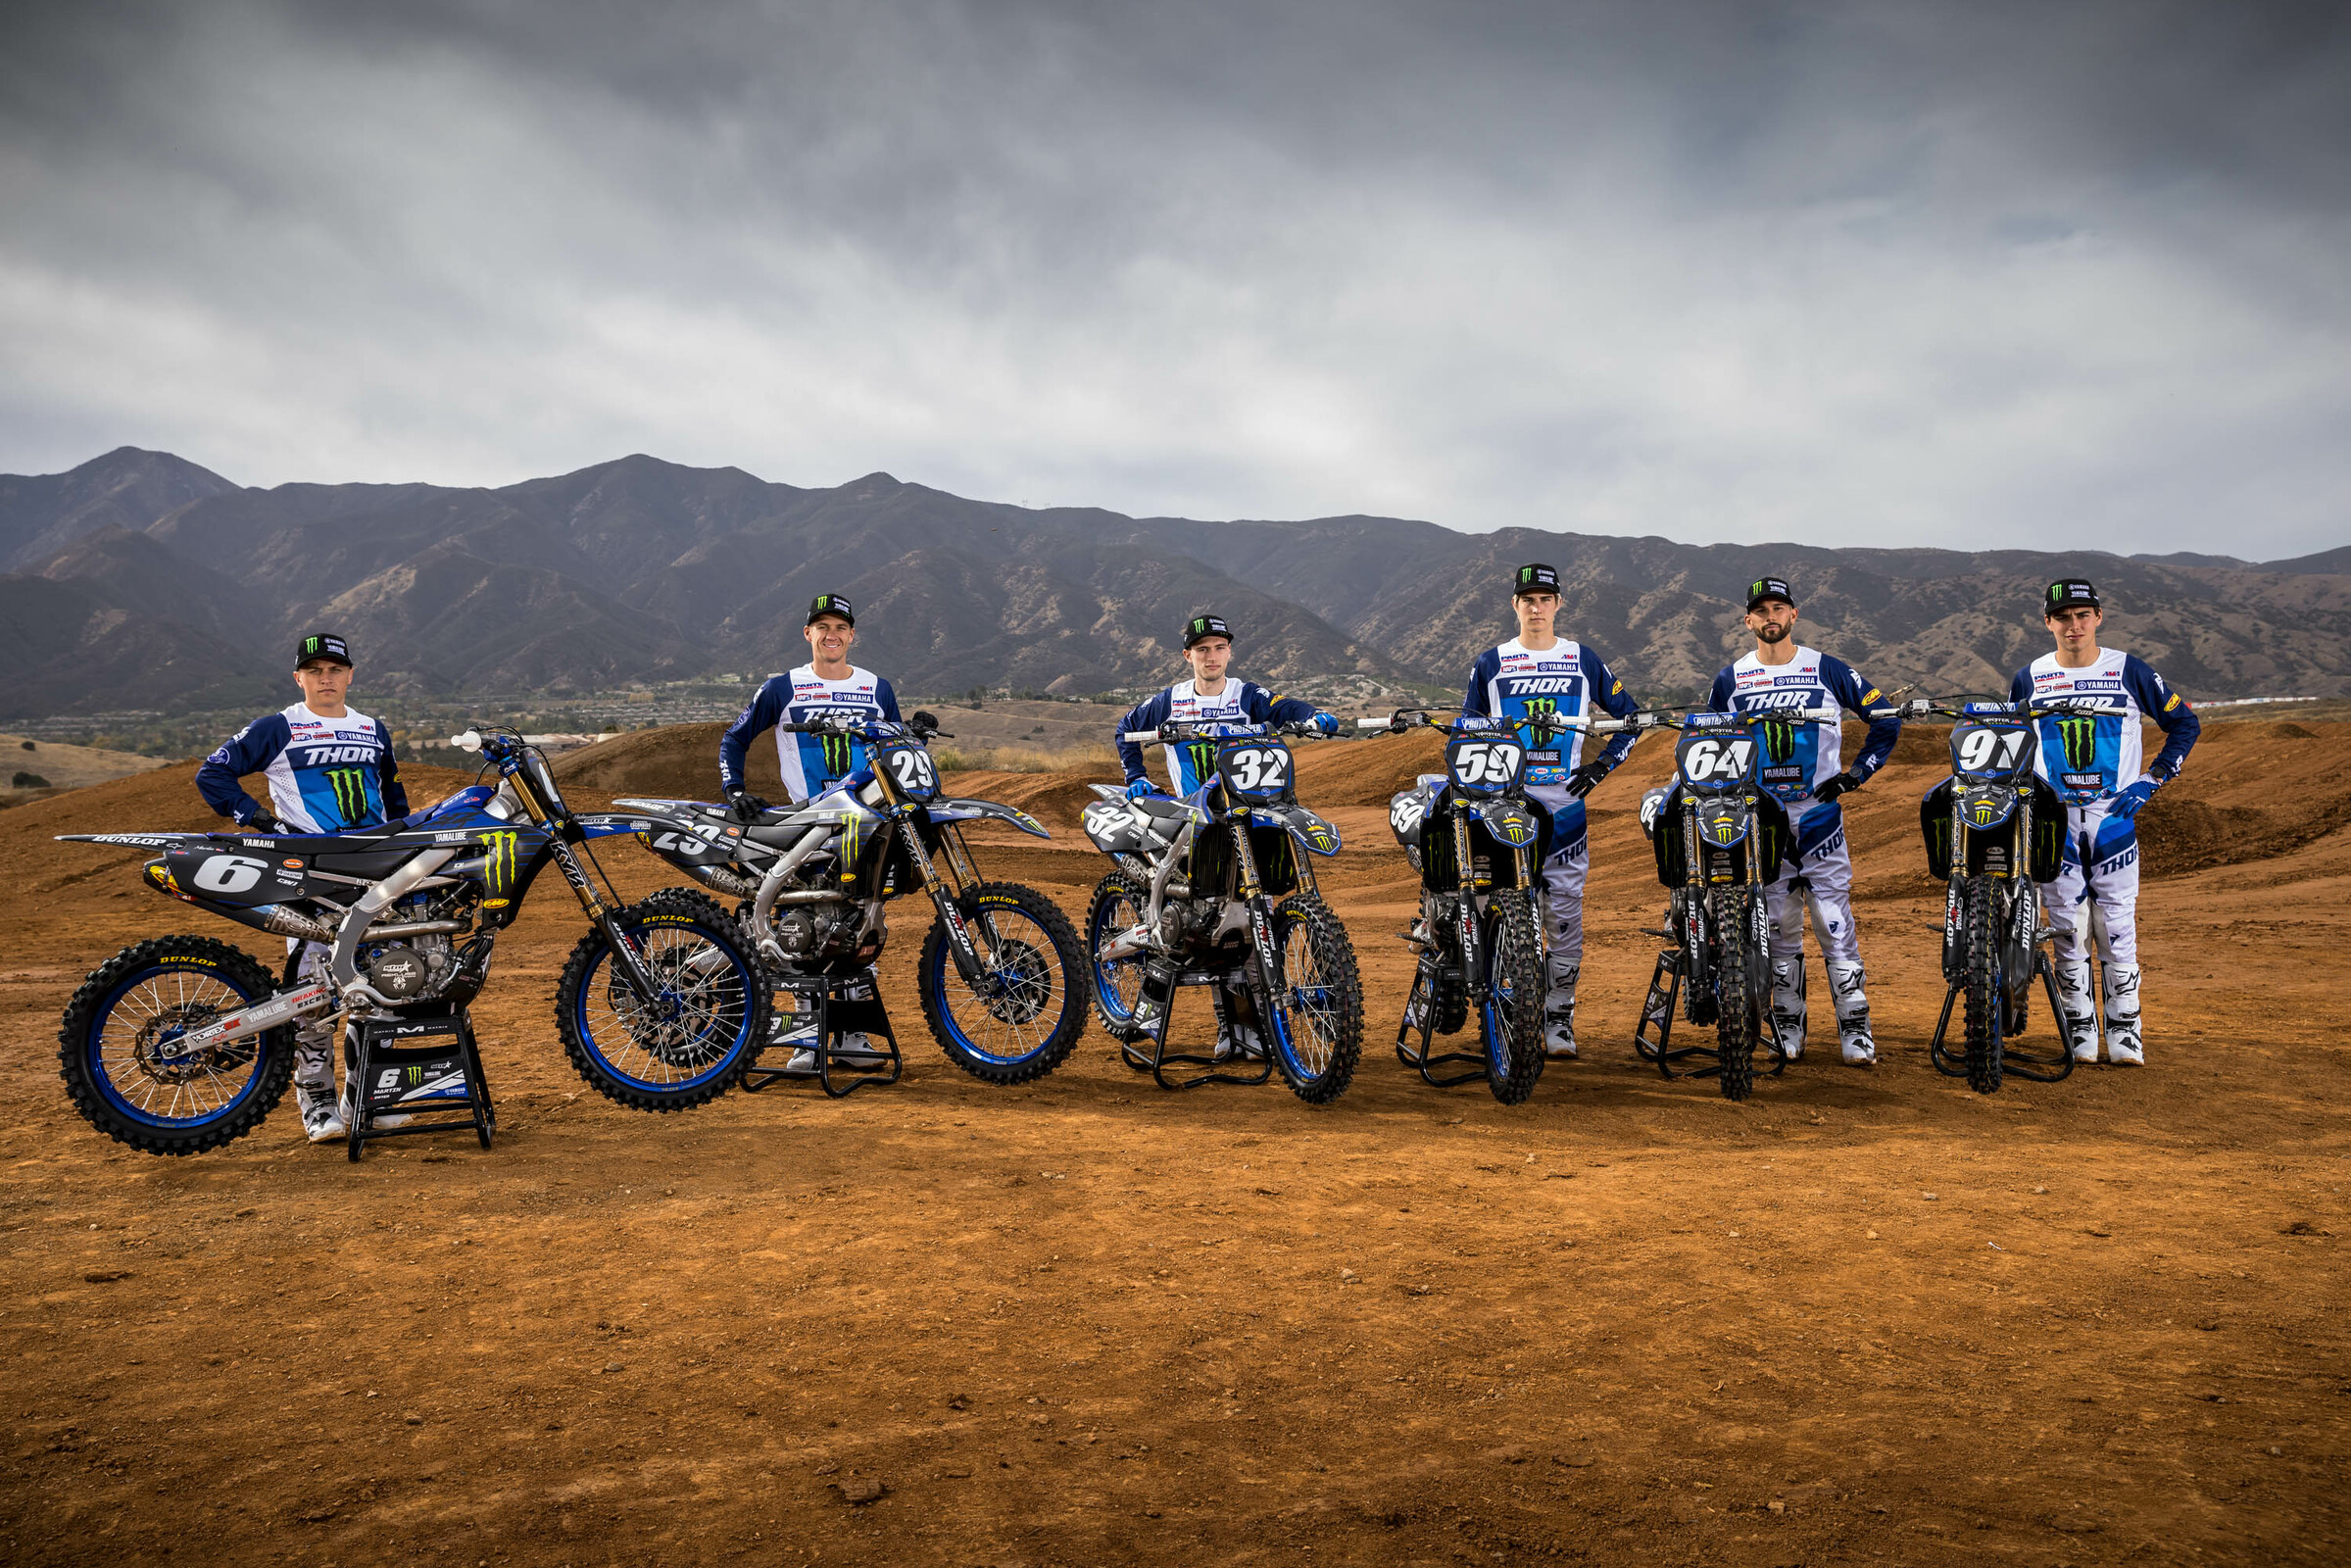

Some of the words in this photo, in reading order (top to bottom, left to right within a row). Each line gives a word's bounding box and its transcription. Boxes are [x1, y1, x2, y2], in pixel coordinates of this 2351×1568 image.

[2034, 671, 2065, 680] PARTS
[1508, 678, 1573, 695] THOR
[2086, 681, 2119, 690] YAMAHA
[1744, 691, 1812, 710] THOR
[1212, 708, 1238, 716] YAMAHA
[347, 733, 376, 743] YAMAHA
[304, 747, 376, 765] THOR
[1526, 752, 1559, 761] YAMALUBE
[1960, 729, 2027, 770] 91
[892, 750, 934, 789] 29
[1231, 749, 1289, 790] 32
[1455, 744, 1521, 783] 59
[1685, 740, 1752, 781] 64
[1764, 766, 1800, 778] YAMALUBE
[2063, 773, 2100, 785] YAMALUBE
[627, 801, 664, 810] DUNLOP
[706, 808, 726, 817] YAMAHA
[1391, 798, 1425, 833] 59
[1087, 807, 1135, 843] 32
[92, 836, 168, 846] DUNLOP
[242, 838, 275, 849] YAMAHA
[434, 833, 466, 842] YAMALUBE
[653, 819, 721, 856] 29
[193, 855, 269, 893] 6
[550, 841, 587, 890] KYB
[979, 896, 1019, 905] DUNLOP
[642, 915, 695, 924] DUNLOP
[1947, 889, 1956, 947] DUNLOP
[2022, 890, 2033, 951] DUNLOP
[944, 902, 974, 956] DUNLOP
[1460, 904, 1474, 962] DUNLOP
[1688, 900, 1698, 959] DUNLOP
[1756, 897, 1769, 959] DUNLOP
[1254, 910, 1274, 968] DUNLOP
[160, 956, 218, 967] DUNLOP
[292, 987, 326, 1004] BRAKING
[297, 995, 328, 1009] EXCEL
[247, 1002, 288, 1023] YAMALUBE
[190, 1026, 226, 1044] VORTEX
[377, 1068, 401, 1089] 6
[373, 1087, 402, 1096] MARTIN
